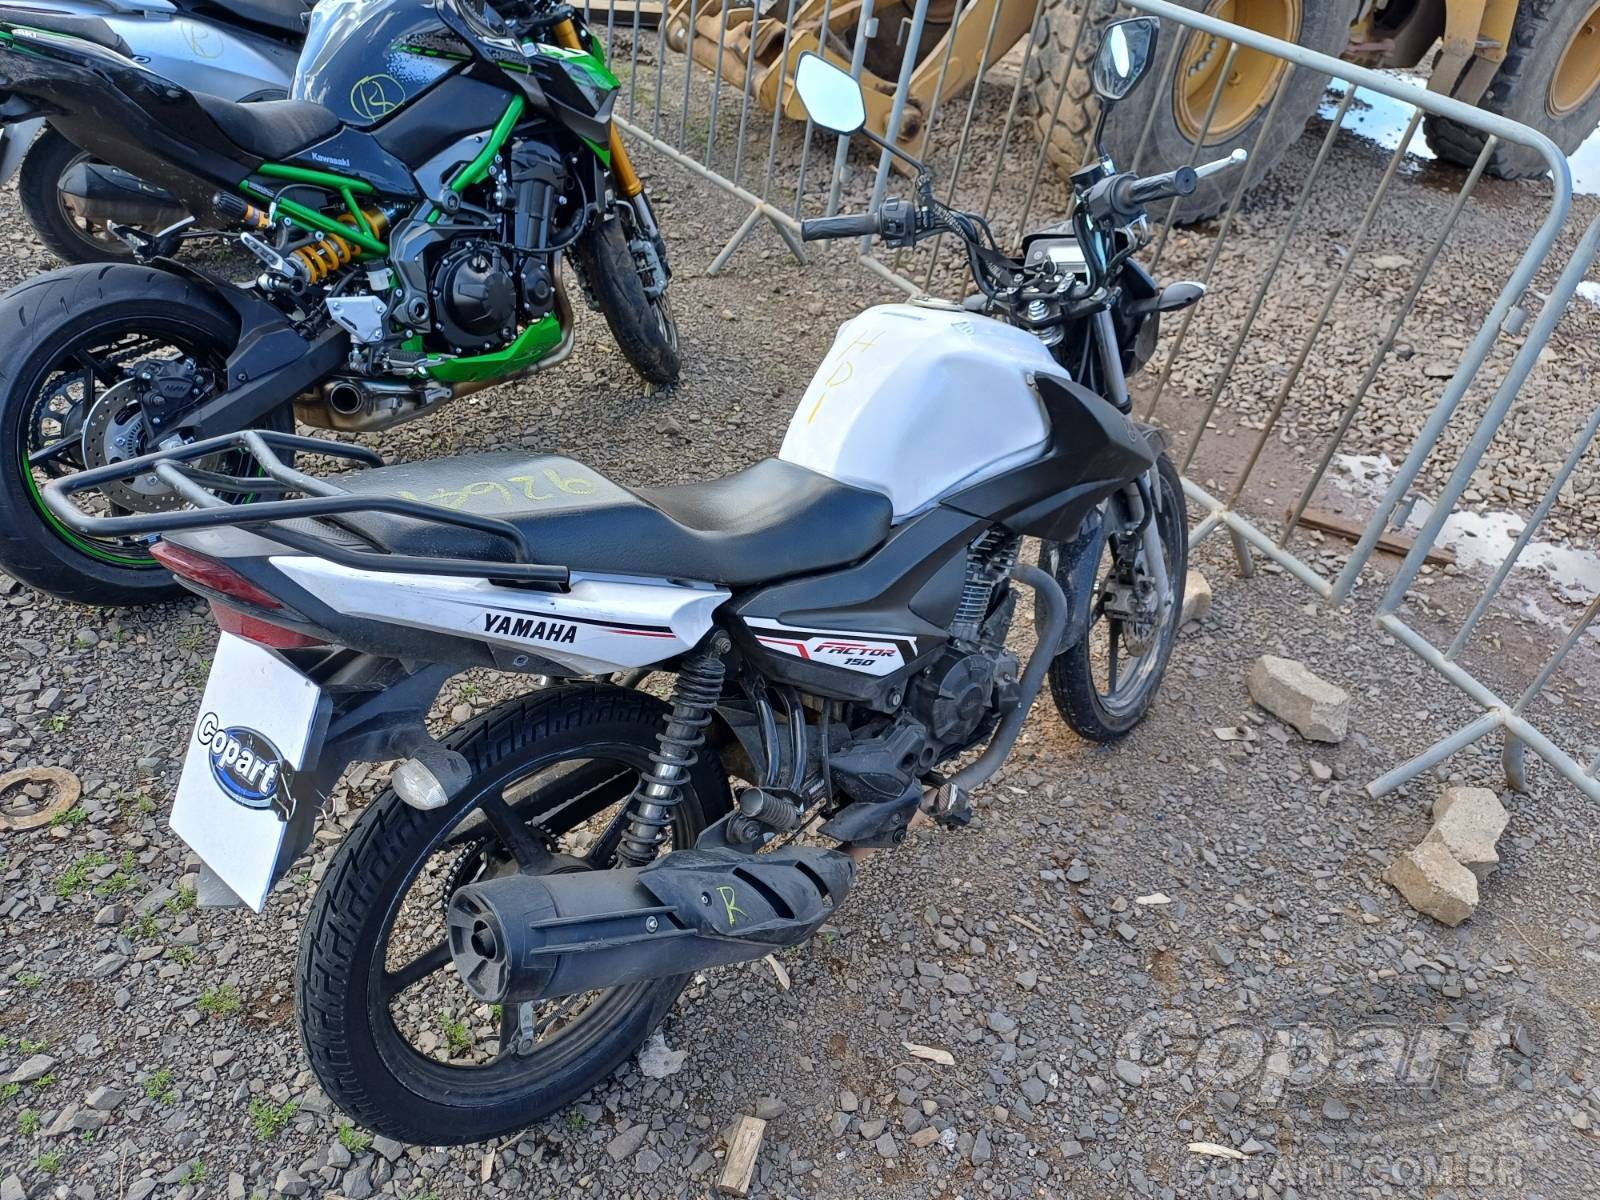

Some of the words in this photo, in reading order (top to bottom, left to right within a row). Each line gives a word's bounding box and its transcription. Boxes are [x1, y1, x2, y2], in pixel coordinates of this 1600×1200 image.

[311, 152, 351, 167] Kawasaki
[484, 613, 578, 643] YAMAHA
[813, 641, 897, 657] FACTOR
[843, 658, 876, 667] 150
[198, 712, 281, 797] Copart
[716, 886, 752, 927] R
